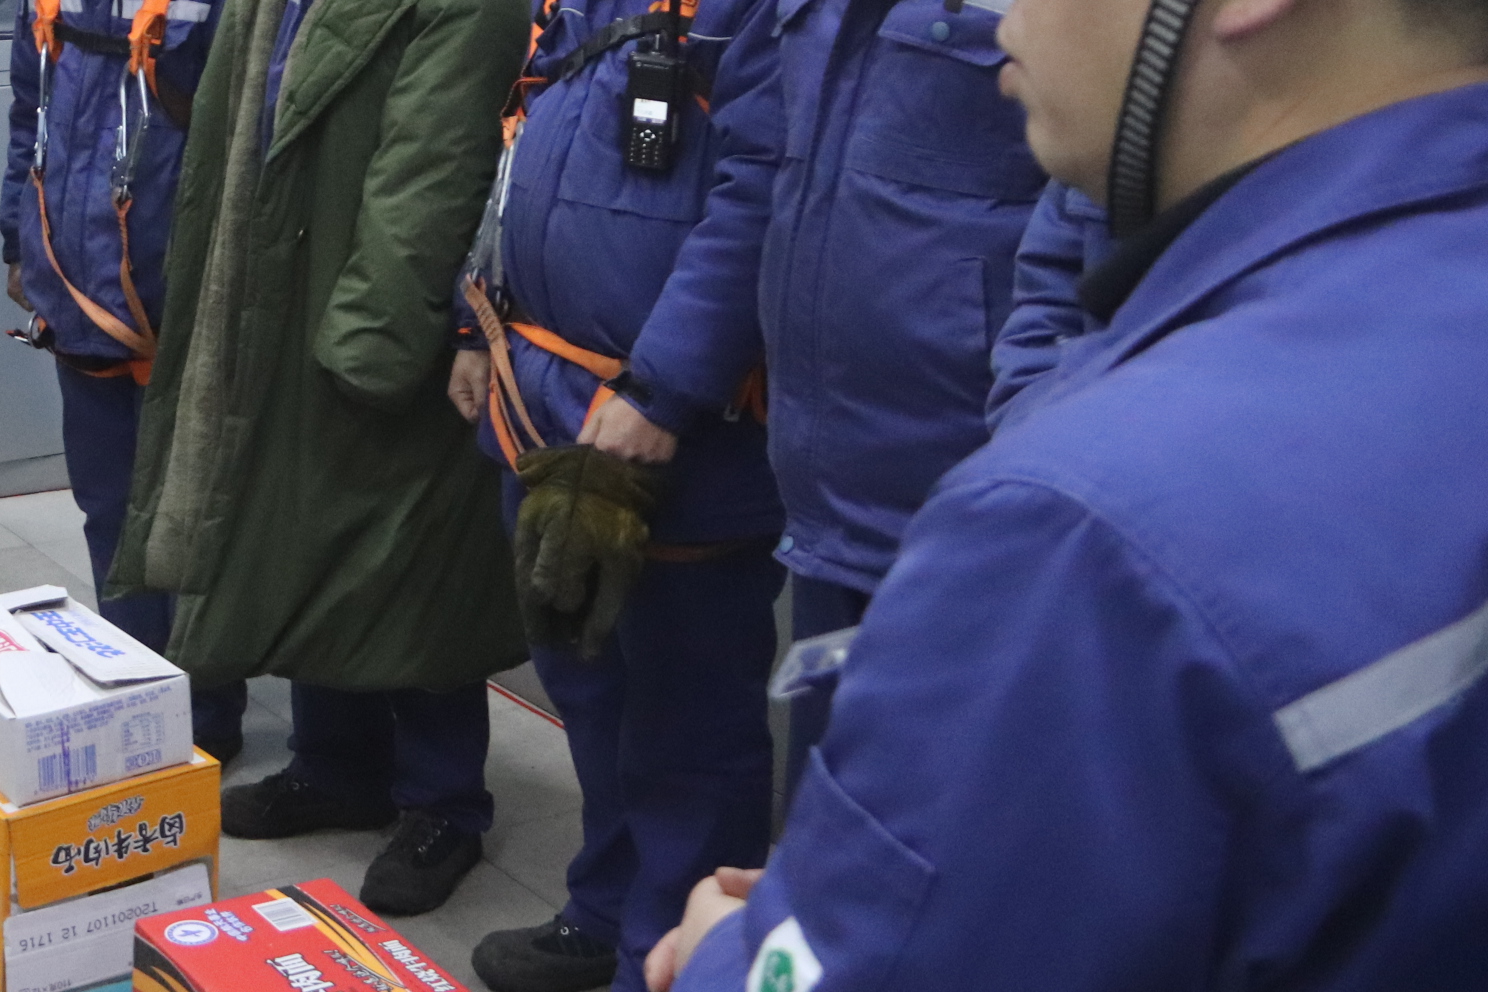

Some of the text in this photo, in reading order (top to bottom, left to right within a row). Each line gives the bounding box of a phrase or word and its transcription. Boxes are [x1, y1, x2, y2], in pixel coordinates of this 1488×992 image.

[51, 812, 185, 874] 卤香牛肉面
[86, 900, 159, 934] T20201107
[19, 931, 53, 952] 1716
[62, 924, 78, 940] 12
